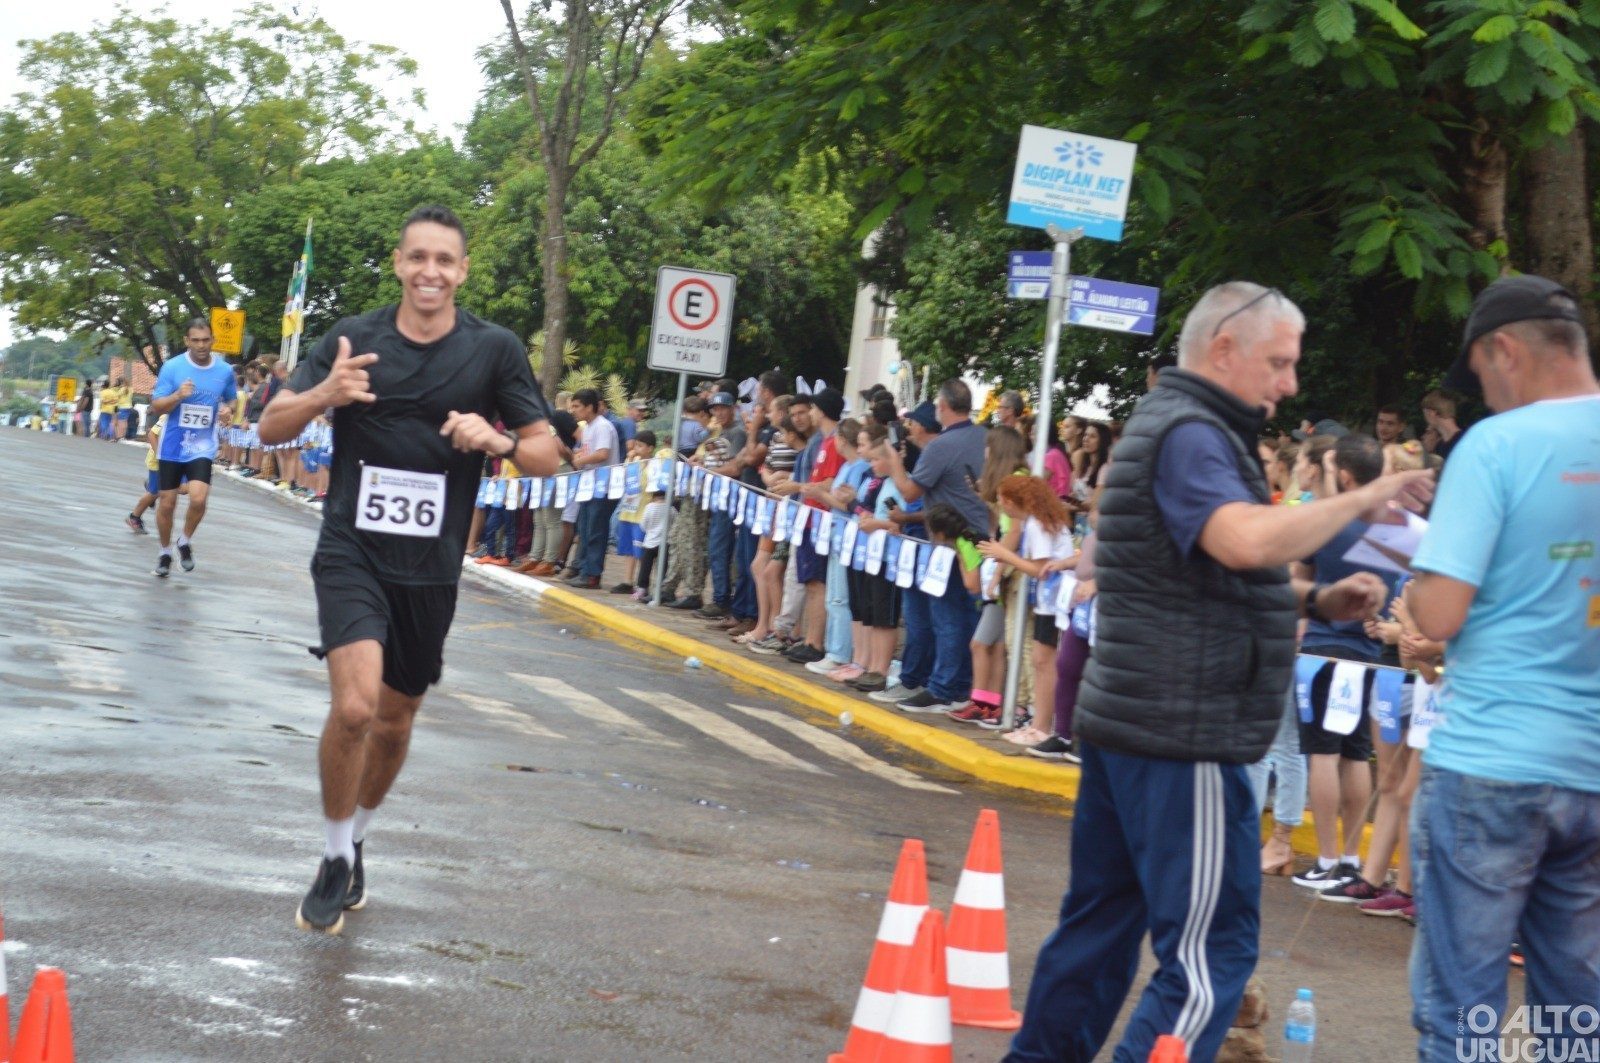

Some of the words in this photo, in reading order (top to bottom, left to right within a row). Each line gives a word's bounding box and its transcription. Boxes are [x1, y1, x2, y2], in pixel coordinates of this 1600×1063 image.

[1024, 162, 1092, 187] DIGIPLAN
[1098, 176, 1125, 193] NET
[685, 291, 703, 318] E
[1072, 290, 1086, 302] DR.
[1088, 290, 1118, 308] ÁLVARO
[657, 334, 721, 352] EXCLUSIVO
[183, 413, 210, 426] 576
[365, 493, 436, 528] 536
